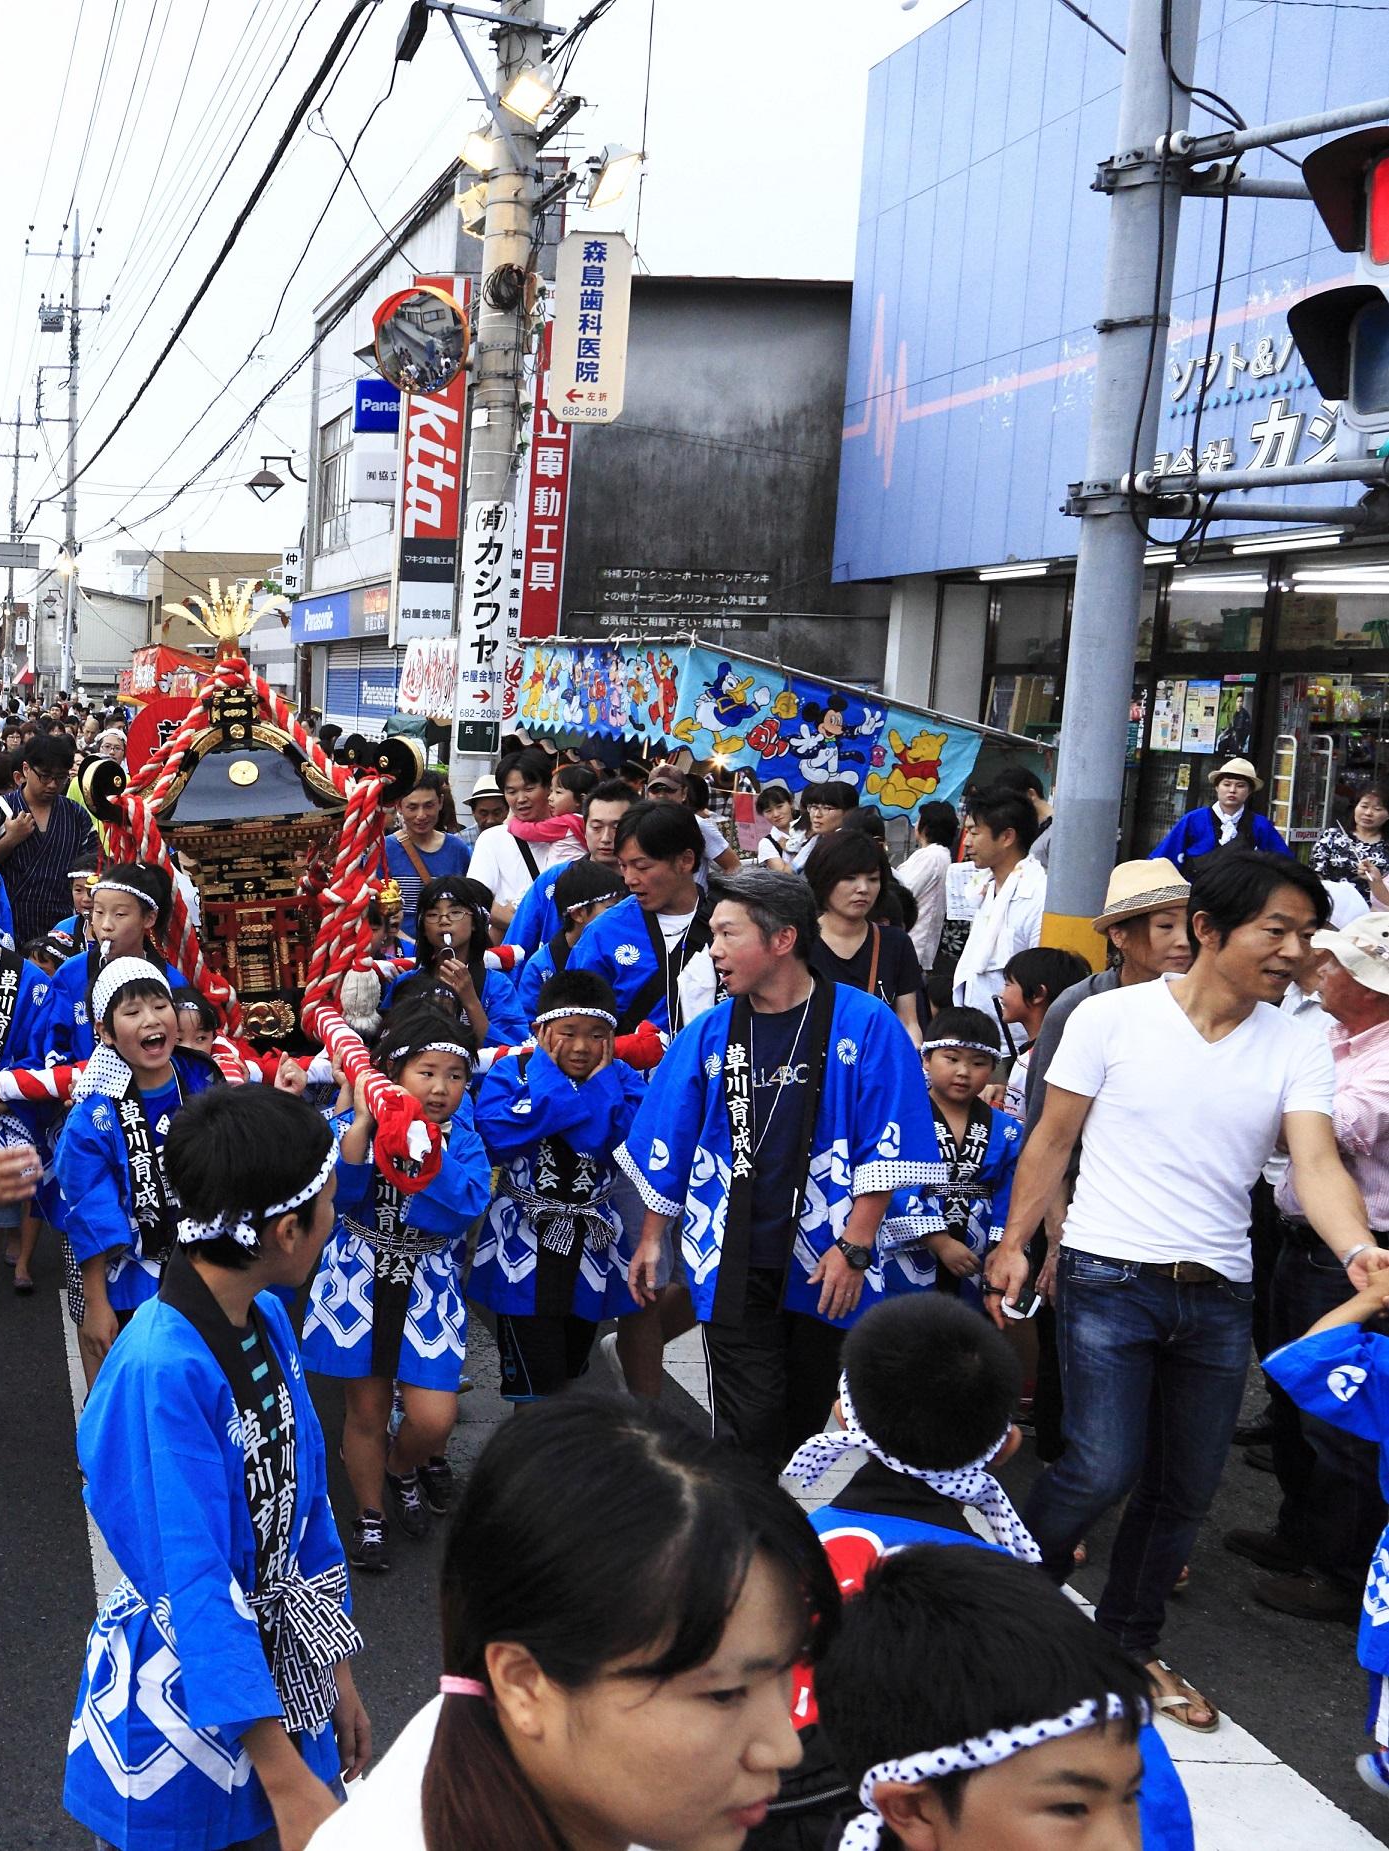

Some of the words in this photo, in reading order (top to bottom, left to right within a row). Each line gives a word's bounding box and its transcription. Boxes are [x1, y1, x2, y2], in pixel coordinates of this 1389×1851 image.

[575, 240, 608, 383] 森島歯科医院
[587, 392, 607, 401] 左折
[561, 406, 608, 418] 682-9218
[285, 552, 299, 587] 仲町
[403, 554, 454, 566] マキタ電動工具
[304, 604, 334, 632] Panasonic
[401, 608, 452, 620] 柏屋金物店
[724, 1043, 752, 1179] 草川育成会
[119, 1100, 161, 1228] 草川育成会
